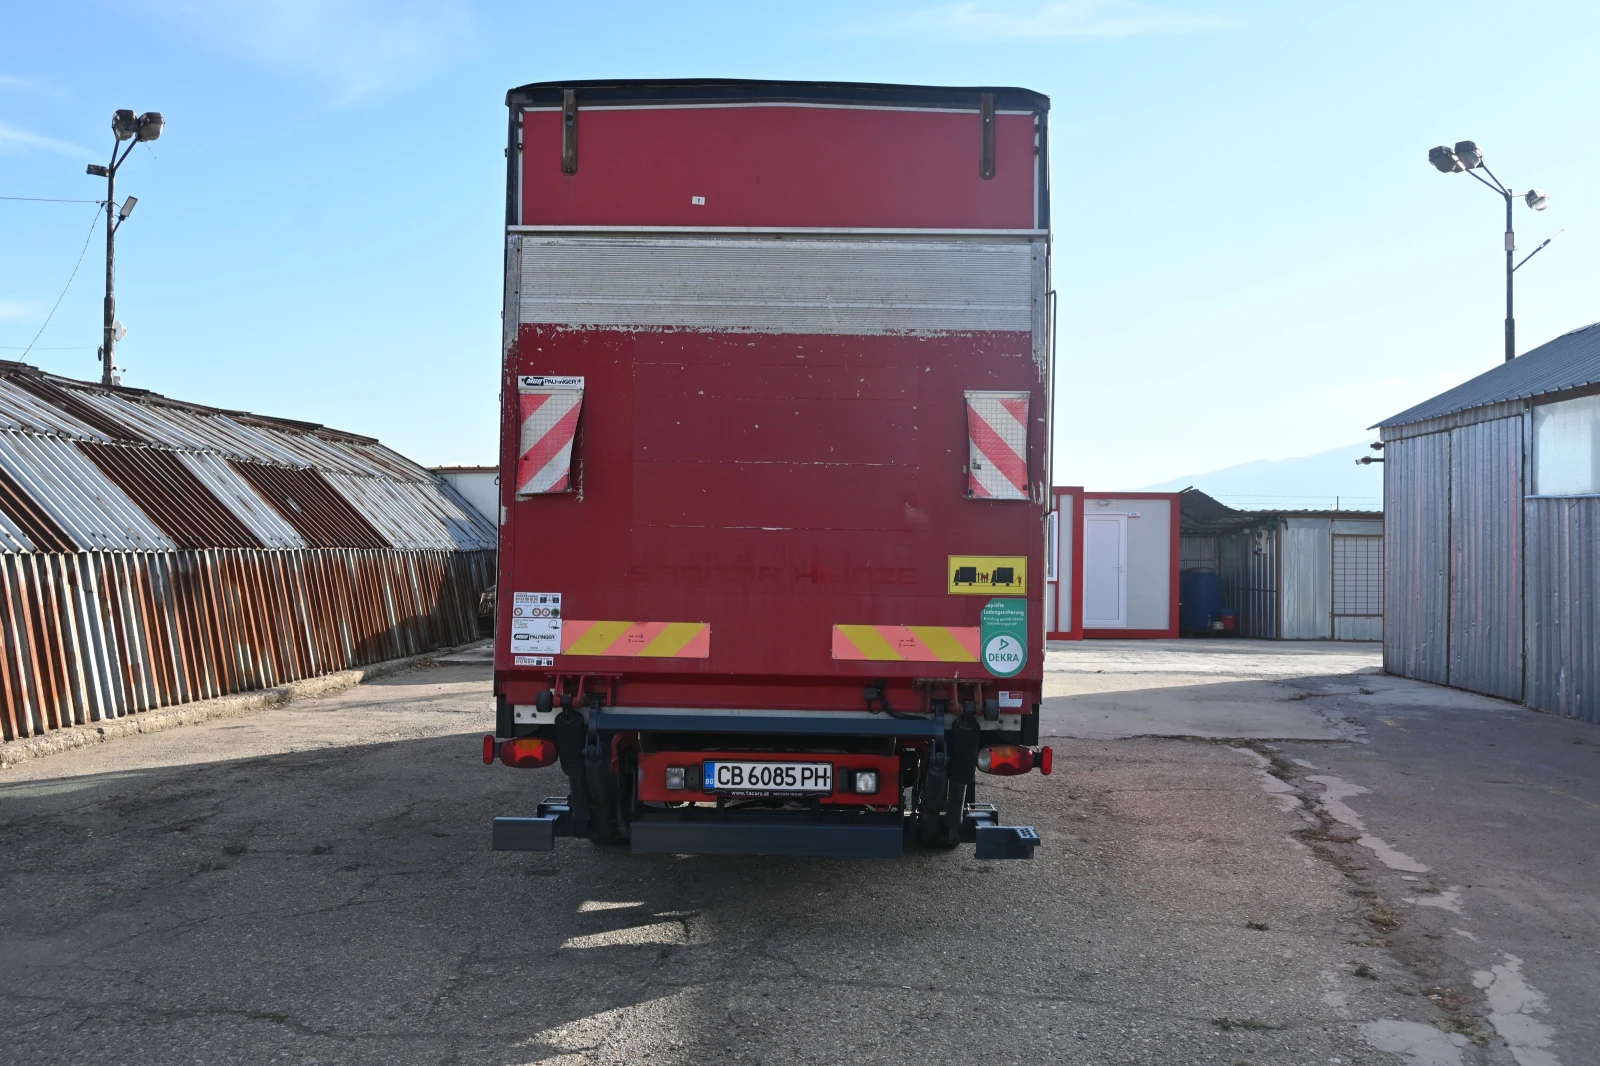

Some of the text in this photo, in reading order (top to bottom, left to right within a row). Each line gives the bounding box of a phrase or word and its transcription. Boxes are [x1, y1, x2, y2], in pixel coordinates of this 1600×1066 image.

[984, 608, 1024, 616] Ladungssicherung
[988, 654, 1019, 662] DEKRA
[718, 766, 828, 787] CB 6085 PH
